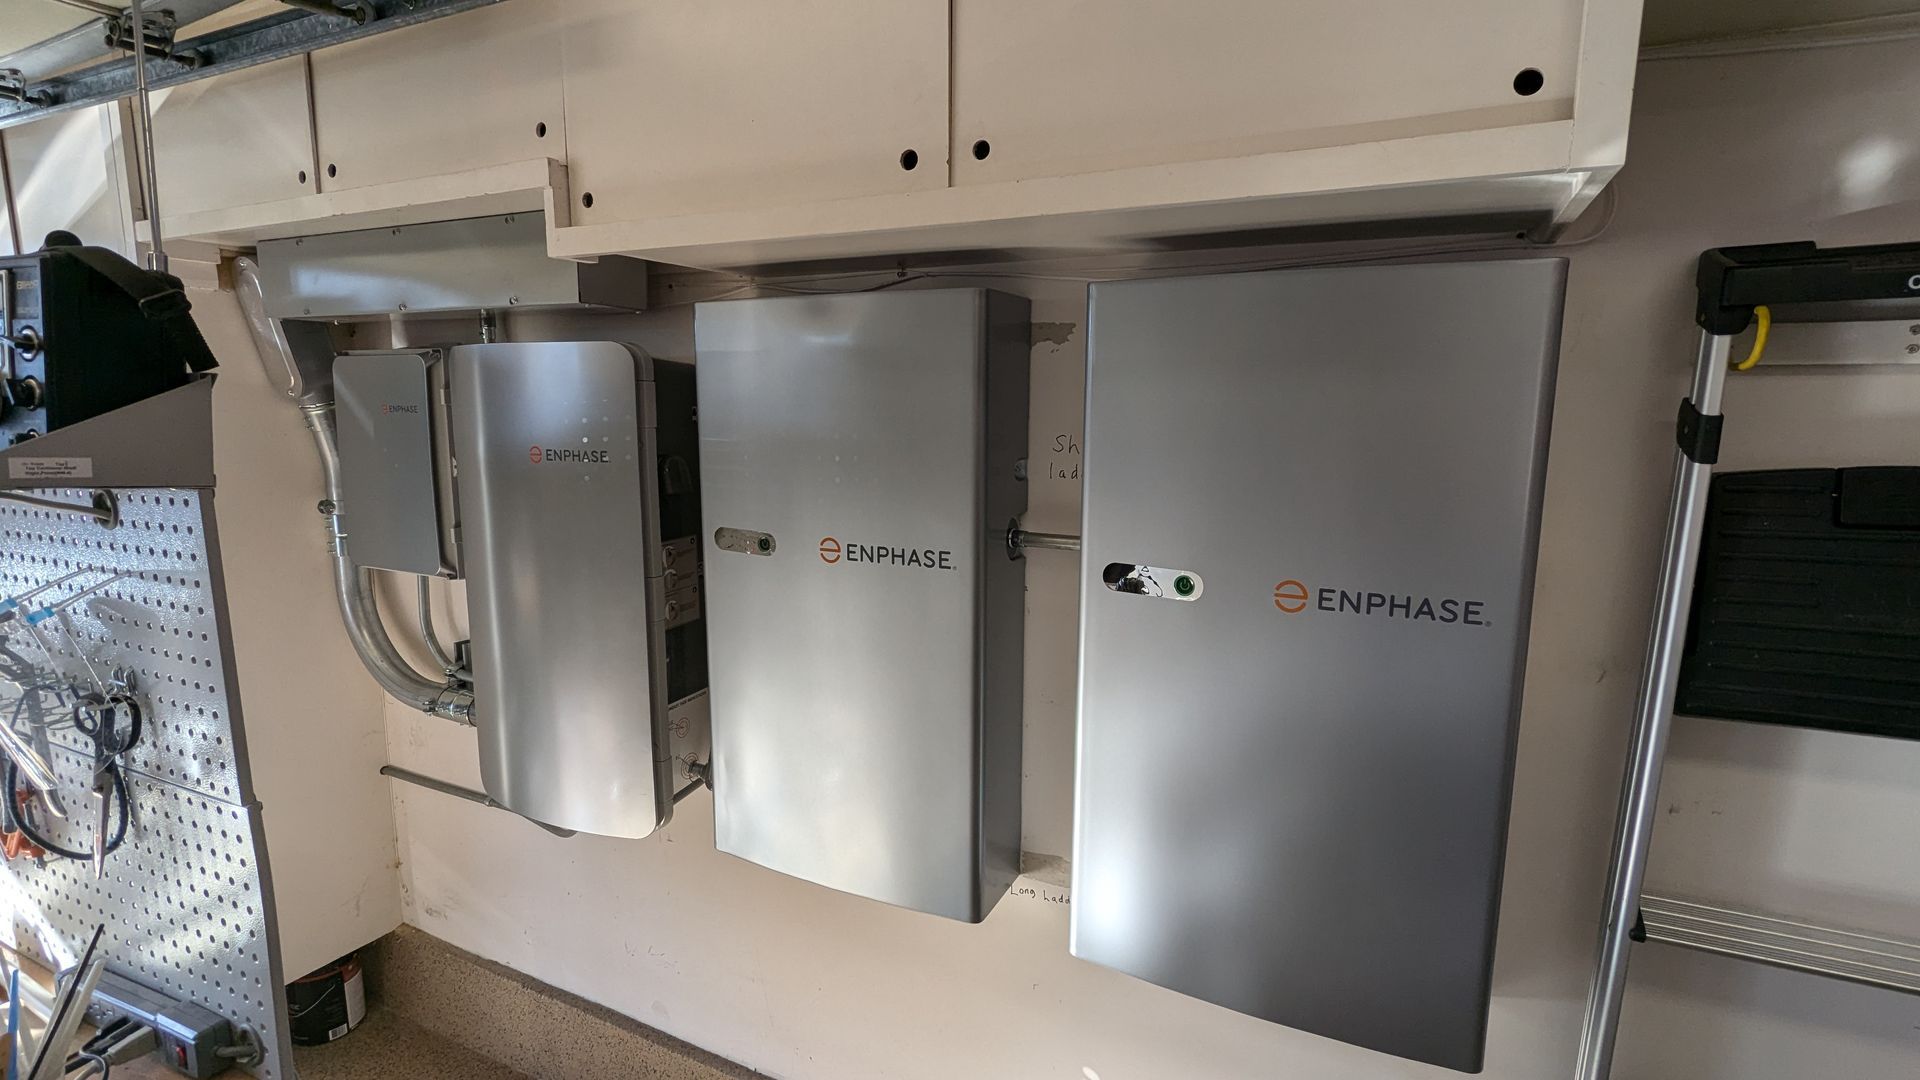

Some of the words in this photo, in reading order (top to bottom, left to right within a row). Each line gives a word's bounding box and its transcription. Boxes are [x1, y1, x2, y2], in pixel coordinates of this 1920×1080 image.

[389, 404, 419, 414] ENPHASE
[545, 448, 609, 463] ENPHASE
[1049, 462, 1082, 480] lad
[846, 543, 952, 570] ENPHASE
[1317, 587, 1484, 626] ENPHASE
[1010, 885, 1036, 899] Long
